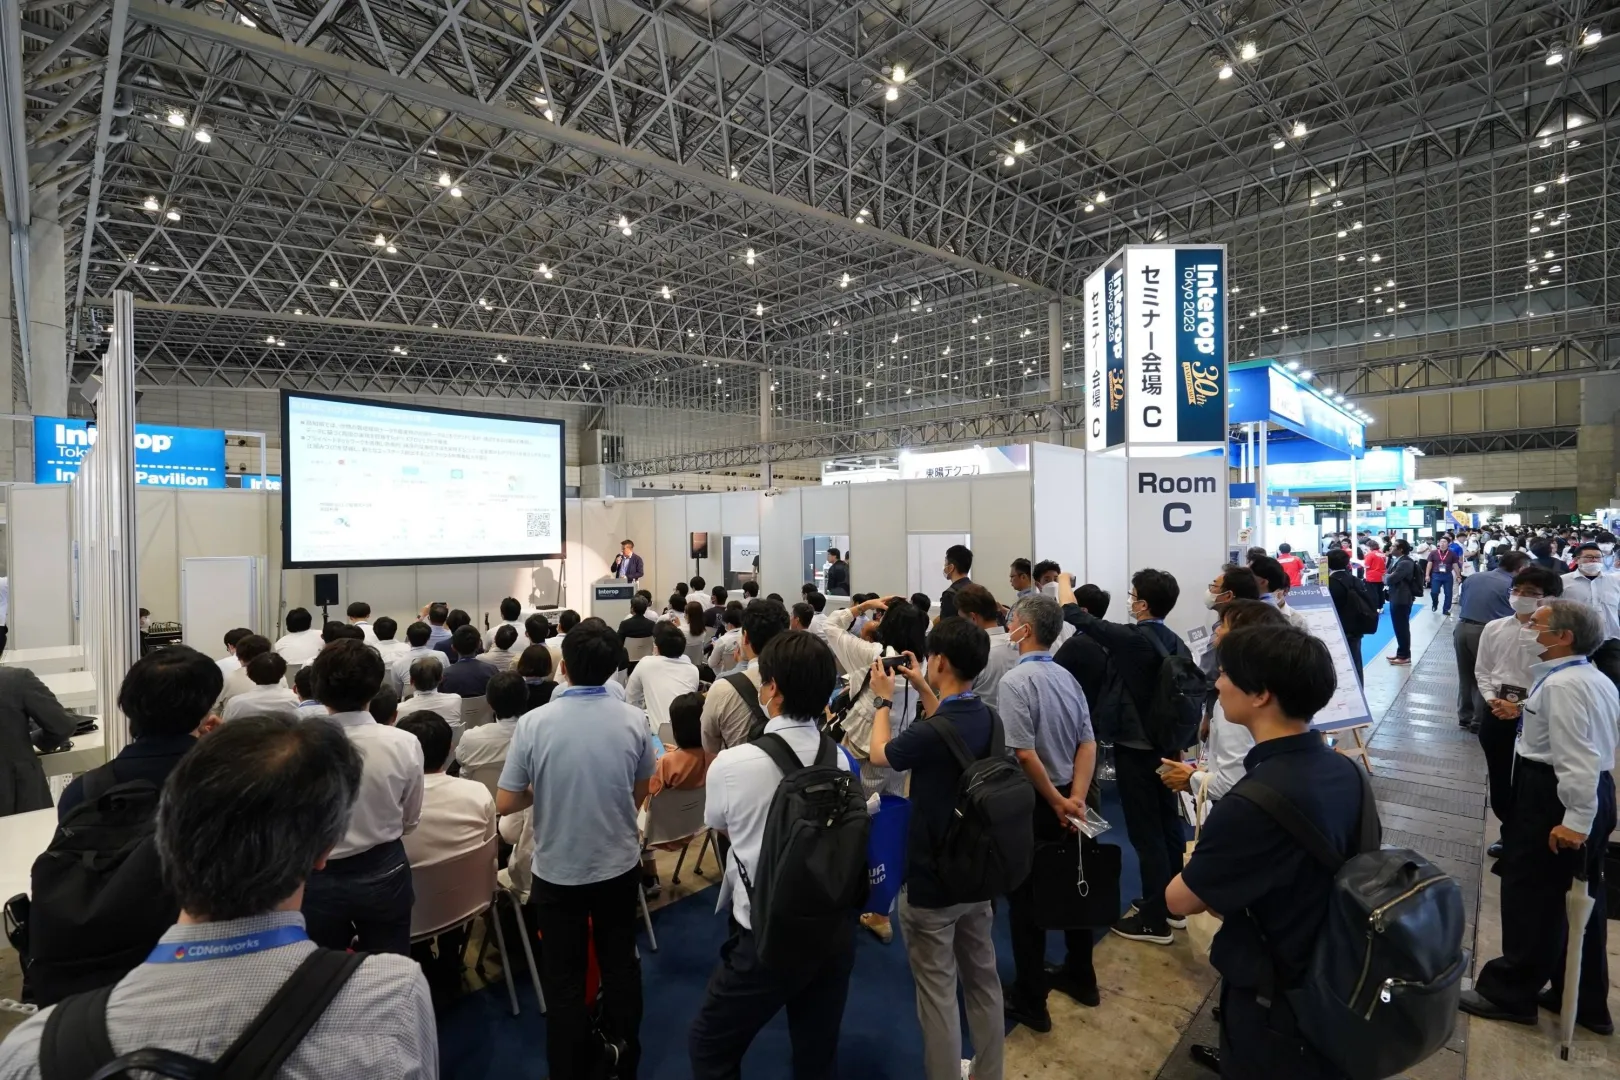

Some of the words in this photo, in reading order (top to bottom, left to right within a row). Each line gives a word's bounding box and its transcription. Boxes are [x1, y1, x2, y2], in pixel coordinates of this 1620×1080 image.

[1181, 265, 1196, 299] Tokyo
[1113, 268, 1124, 359] Interop
[1183, 302, 1195, 332] 2023
[1194, 264, 1218, 354] Interop
[1141, 265, 1163, 395] セミナー会場
[1091, 291, 1101, 408] セミナー会場
[1191, 361, 1219, 406] 30th
[1092, 417, 1100, 438] C
[1143, 405, 1162, 428] C
[55, 424, 171, 453] Intop
[135, 470, 208, 486] Pavilion
[1138, 472, 1216, 494] Room
[1162, 501, 1192, 533] C
[187, 938, 260, 957] CDNetworks
